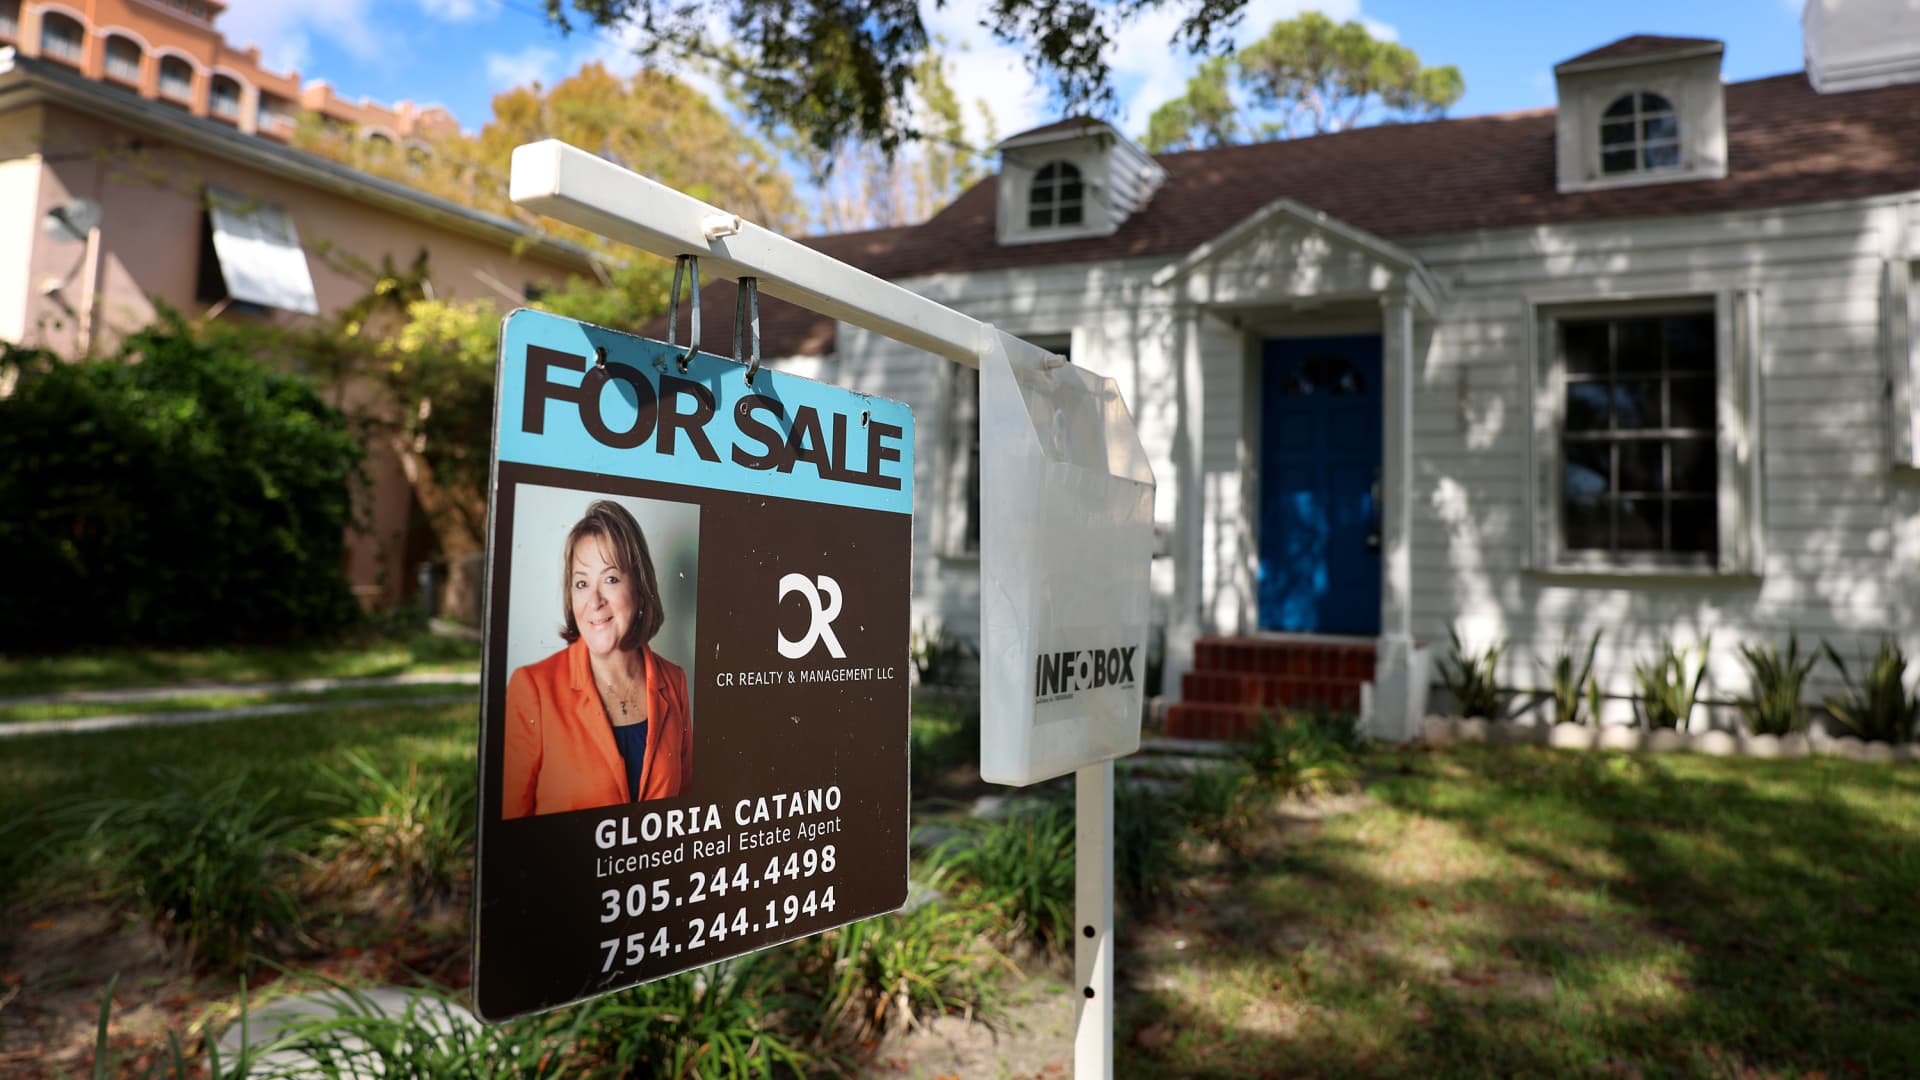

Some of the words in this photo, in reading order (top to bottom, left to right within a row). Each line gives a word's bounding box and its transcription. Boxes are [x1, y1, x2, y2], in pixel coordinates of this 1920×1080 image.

[522, 344, 721, 463] FOR
[731, 394, 902, 490] SALE
[717, 672, 734, 687] CR
[739, 671, 783, 686] REALTY
[787, 670, 796, 683] &
[800, 667, 873, 683] MANAGEMENT
[877, 667, 894, 680] LLC
[595, 804, 722, 849] GLORIA
[735, 786, 841, 826] CATANO
[596, 843, 684, 878] Licensed
[693, 835, 731, 859] Real
[739, 827, 791, 850] Estate
[797, 816, 841, 841] Agent
[600, 845, 836, 923] 305.244.4498
[600, 886, 836, 973] 754.244.1944
